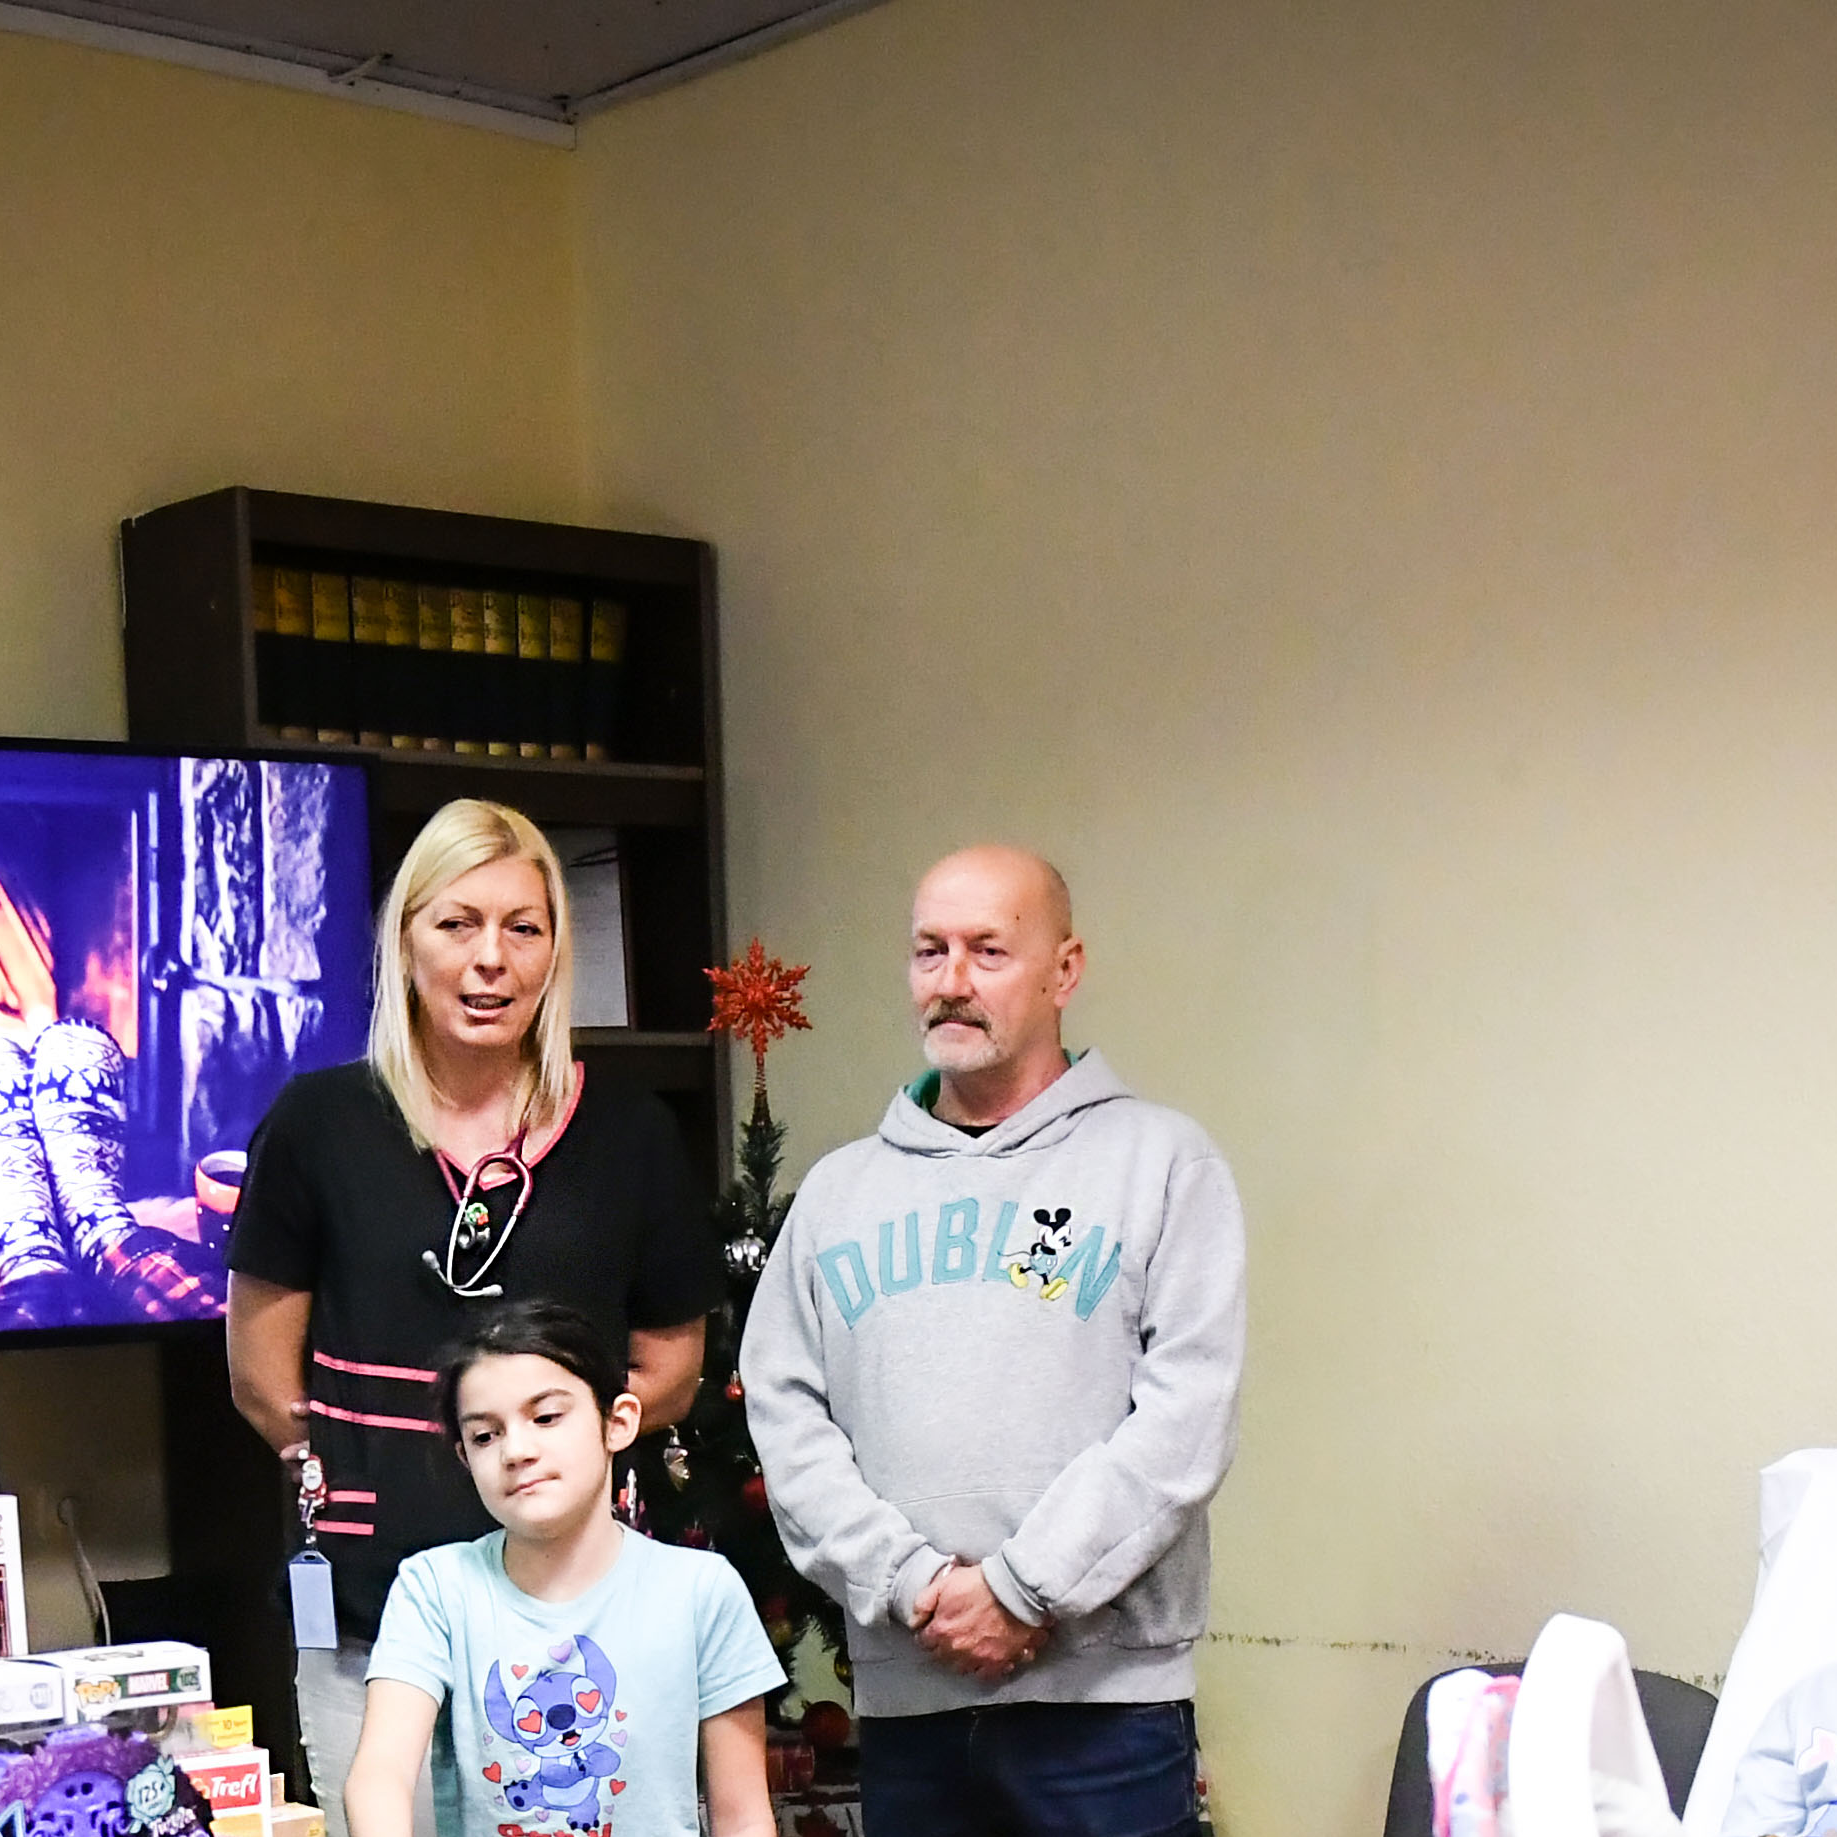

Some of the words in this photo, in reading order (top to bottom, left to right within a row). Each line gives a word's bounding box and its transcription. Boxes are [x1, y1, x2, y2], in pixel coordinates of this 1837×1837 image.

[816, 1197, 1122, 1331] DUBLN
[129, 1673, 168, 1694] MARVEL
[211, 1773, 259, 1799] Trefl
